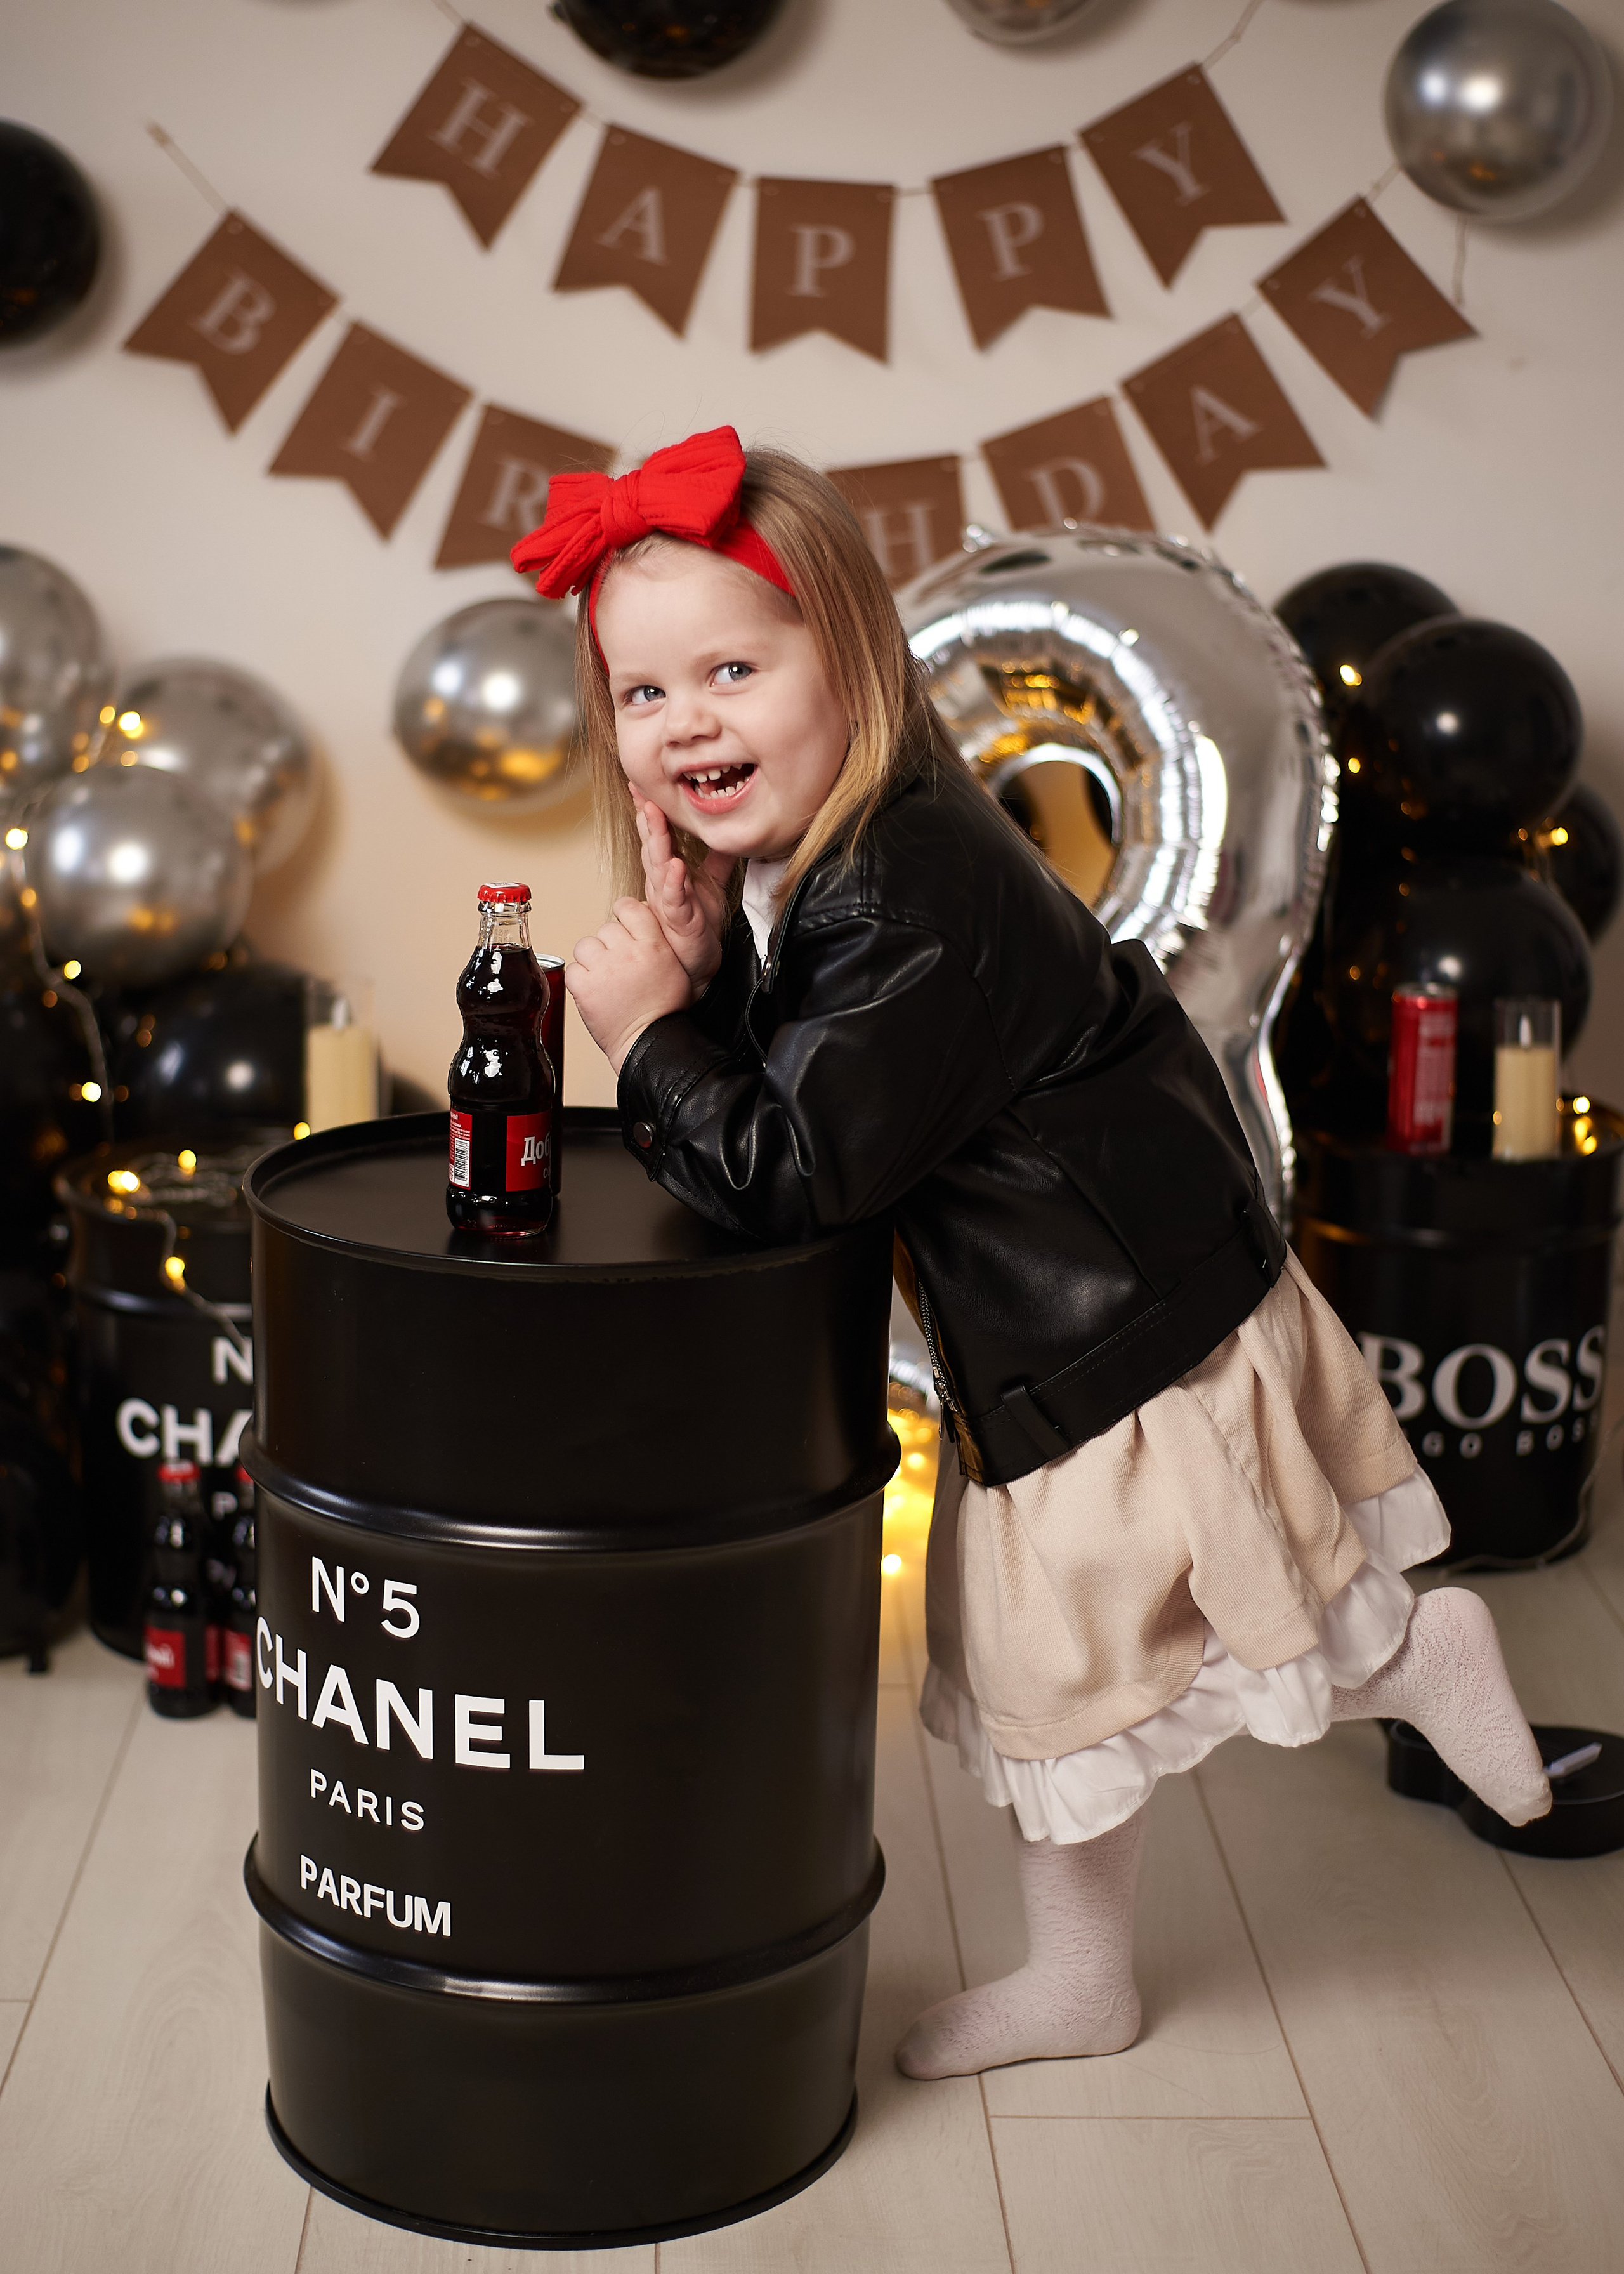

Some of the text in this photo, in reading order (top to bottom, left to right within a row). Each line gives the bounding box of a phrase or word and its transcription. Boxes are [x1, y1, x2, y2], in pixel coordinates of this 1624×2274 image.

[428, 76, 1210, 298] HAPPY
[188, 253, 1393, 579] BIRHDAY
[1359, 1324, 1605, 1429] BOSS
[256, 1616, 584, 1770] CHANEL
[310, 1768, 424, 1831] PARIS
[300, 1854, 451, 1936] PARFUM
